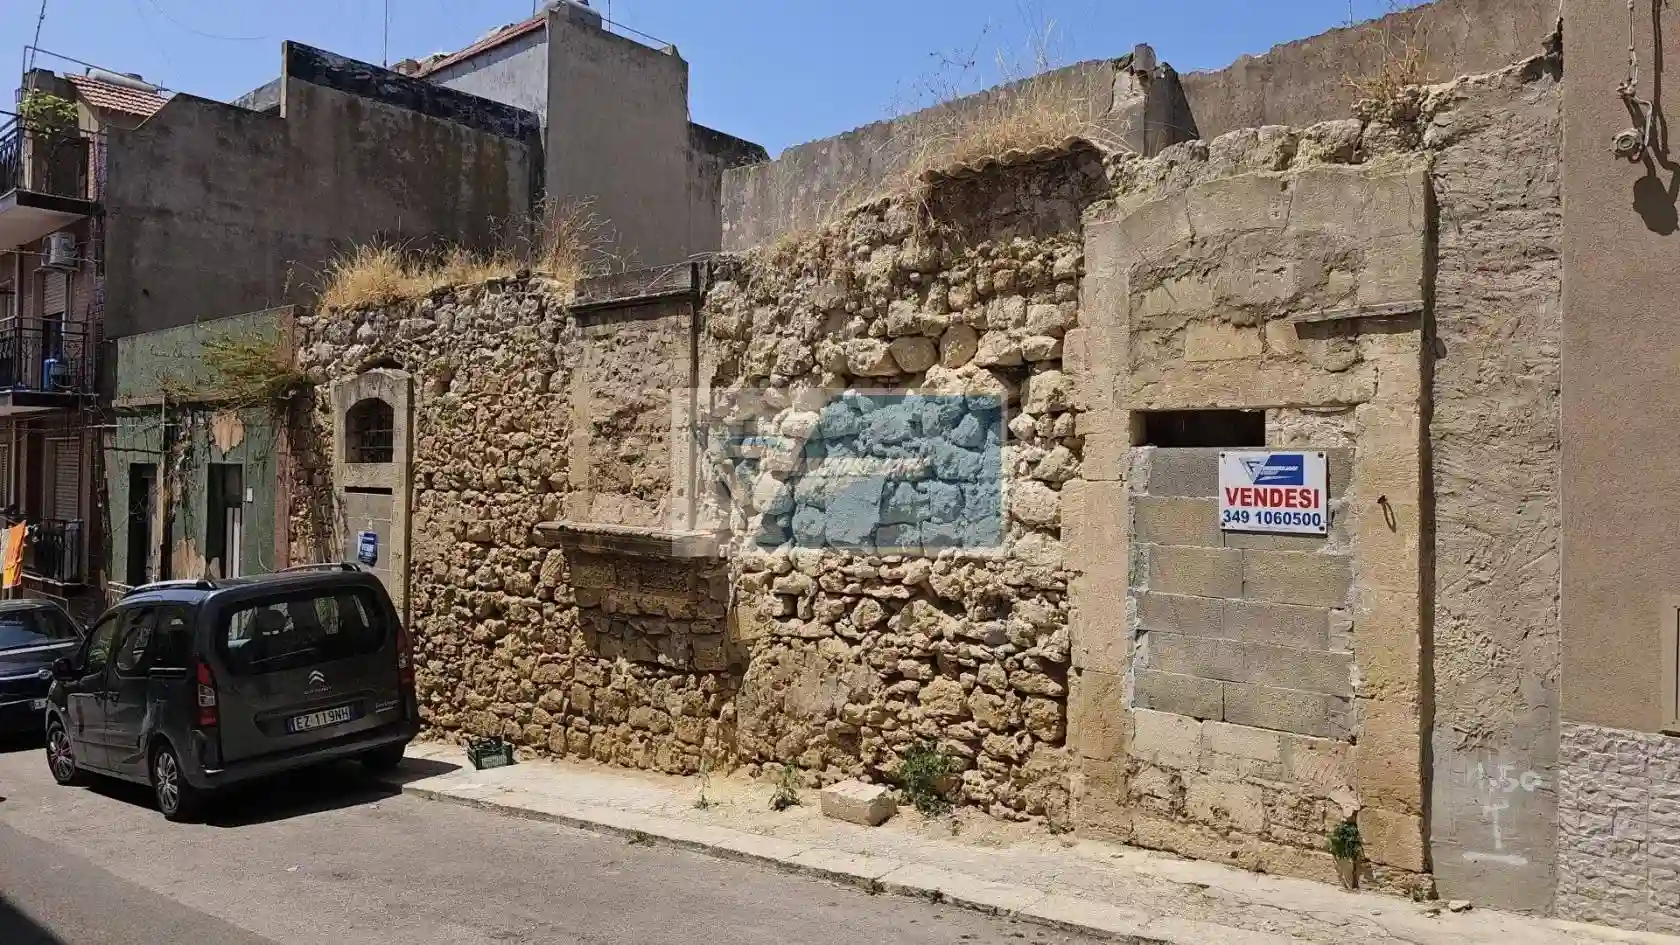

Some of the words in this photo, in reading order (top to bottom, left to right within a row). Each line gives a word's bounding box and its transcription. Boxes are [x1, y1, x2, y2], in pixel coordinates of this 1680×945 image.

[1225, 487, 1320, 509] VENDESI
[1223, 509, 1250, 524] 349
[1255, 511, 1321, 527] 1060500
[295, 715, 311, 729] EZ
